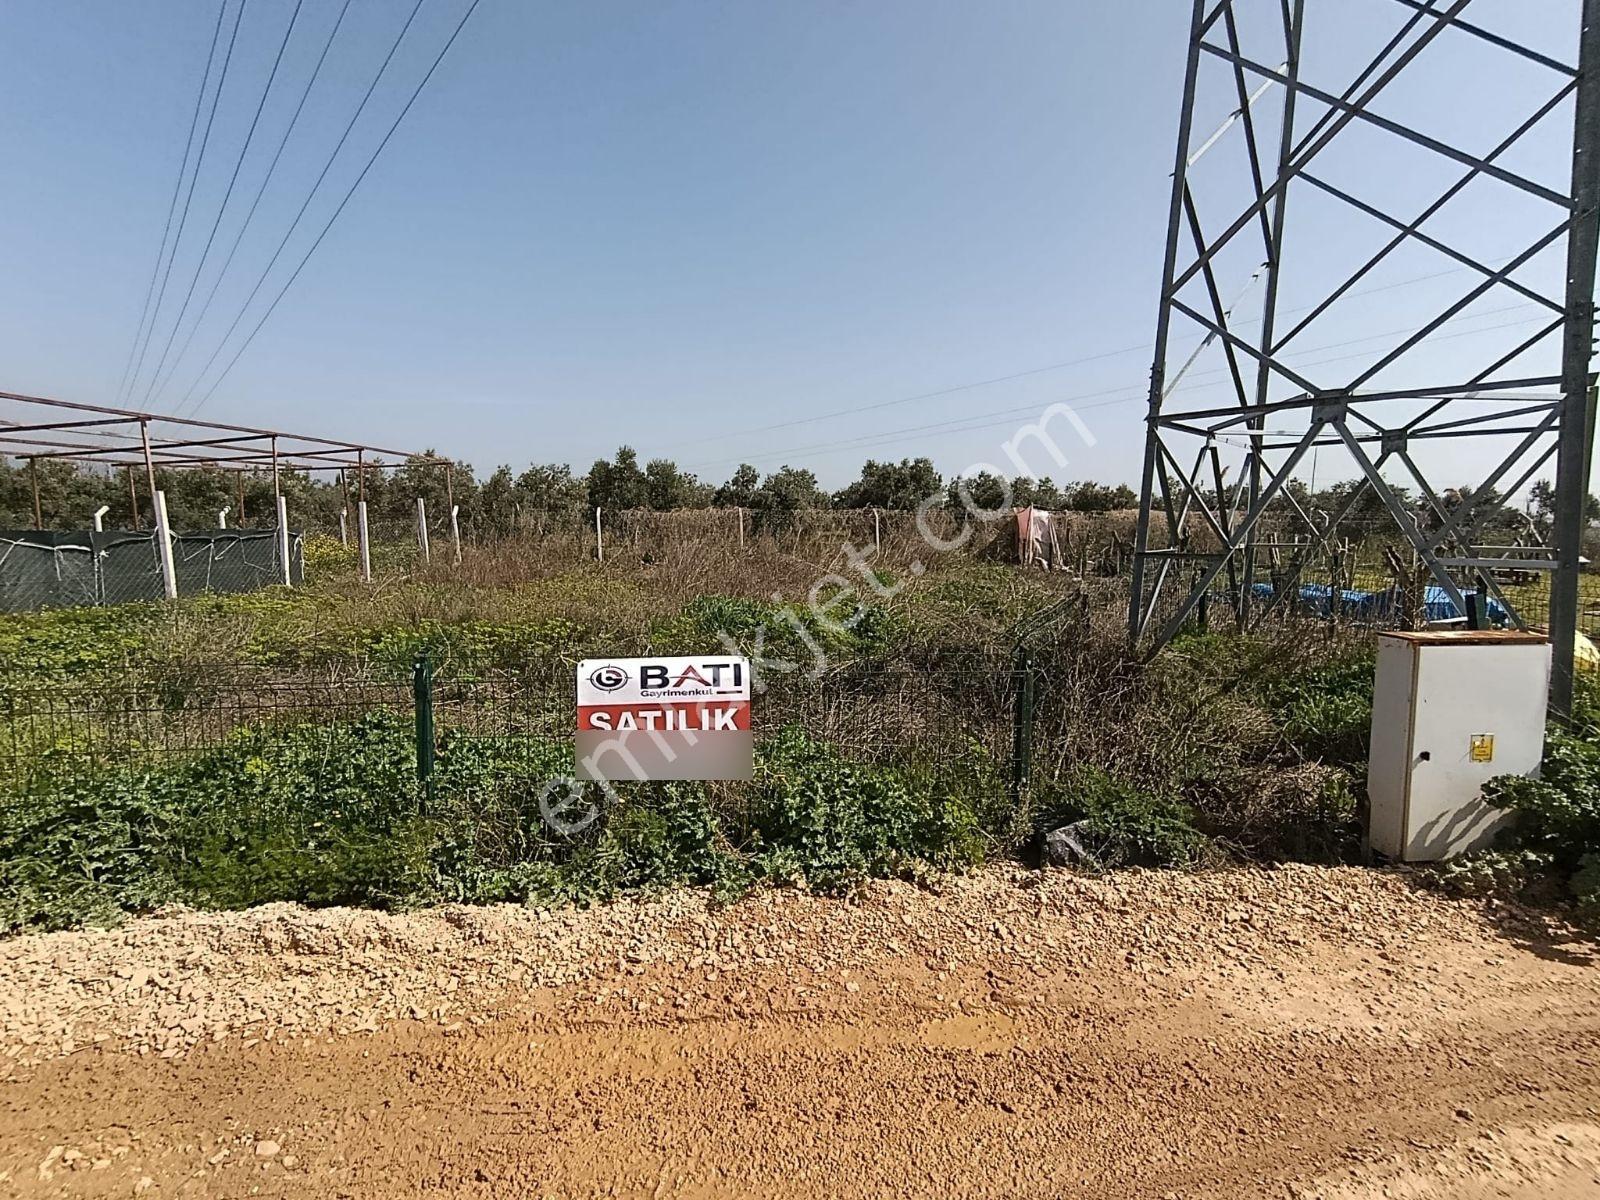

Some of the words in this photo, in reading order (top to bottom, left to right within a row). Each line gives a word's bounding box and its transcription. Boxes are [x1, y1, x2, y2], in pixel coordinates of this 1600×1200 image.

[640, 664, 742, 689] BATI
[640, 688, 713, 698] Gayrimenkul
[589, 708, 739, 731] SATILIK
